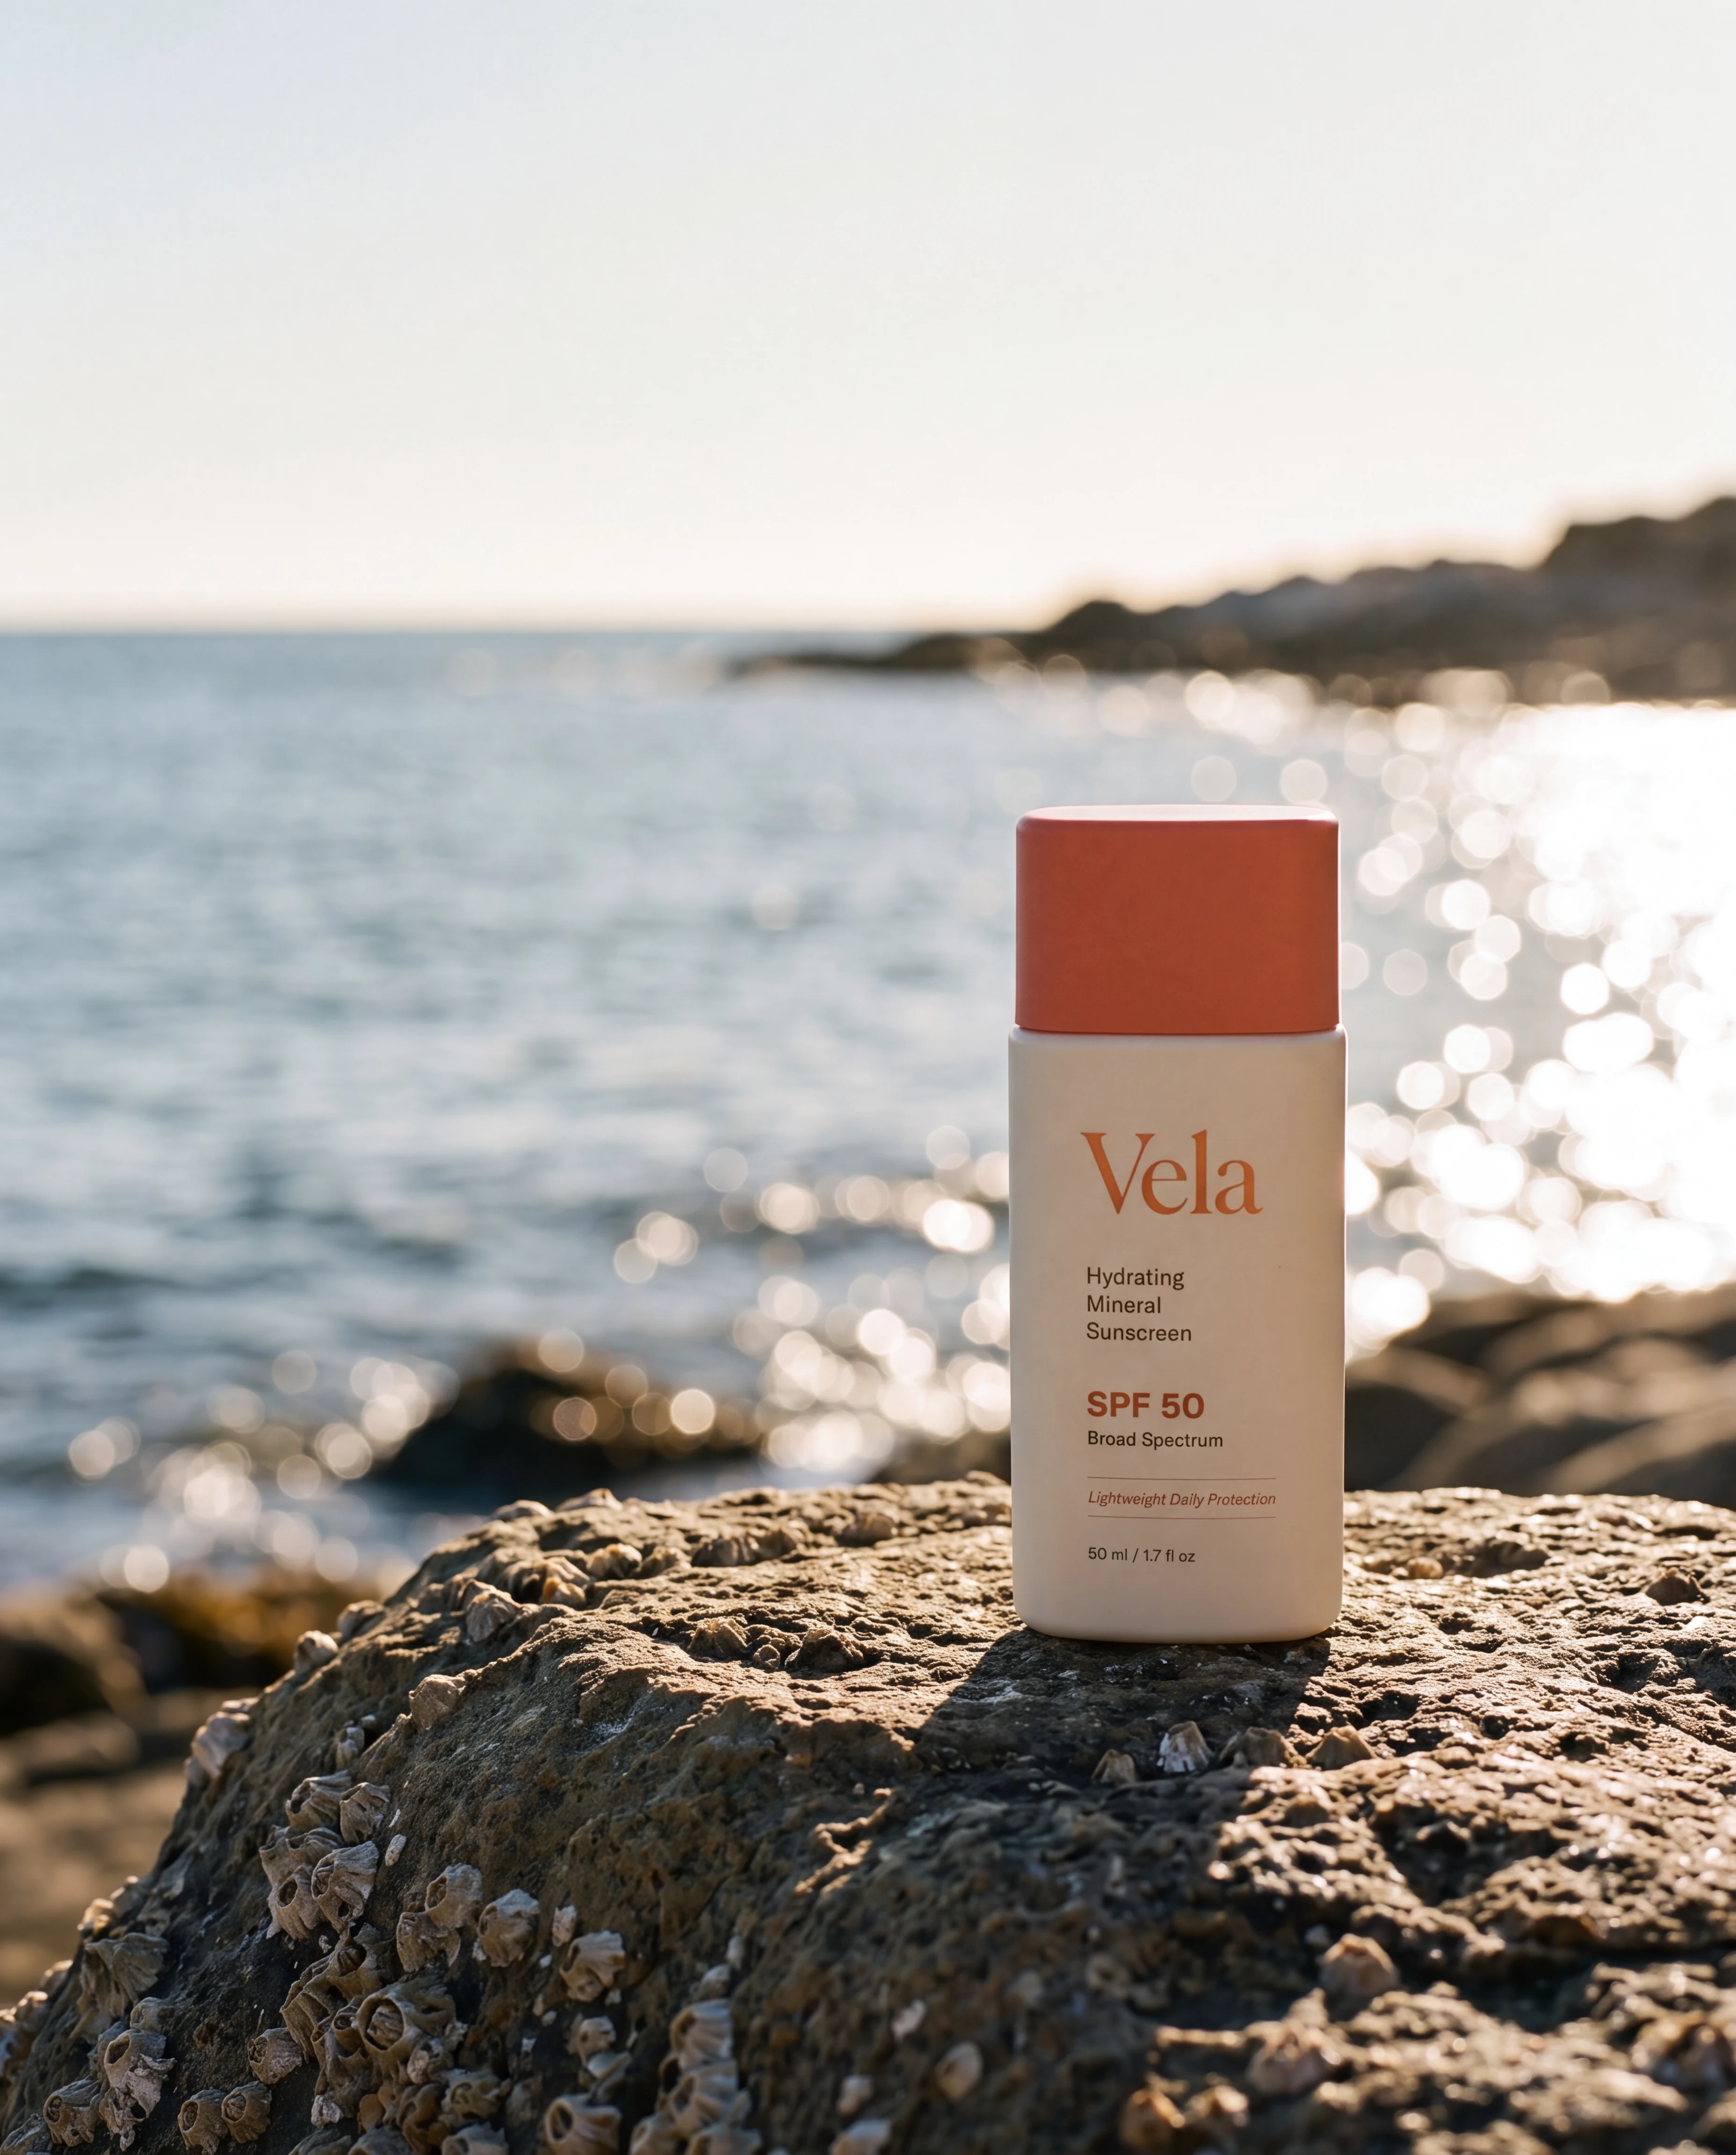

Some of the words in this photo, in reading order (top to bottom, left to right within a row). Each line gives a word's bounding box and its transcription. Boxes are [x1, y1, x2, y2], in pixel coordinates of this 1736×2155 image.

[1080, 1129, 1264, 1215] Vela
[1087, 1266, 1185, 1291] Hydrating
[1087, 1294, 1161, 1314] Mineral
[1086, 1322, 1192, 1342] Sunscreen
[1087, 1391, 1150, 1418] SPF
[1161, 1393, 1205, 1419] 50
[1088, 1430, 1136, 1446] Broad
[1142, 1432, 1223, 1451] Spectrum
[1088, 1491, 1167, 1509] Lightweight
[1170, 1493, 1205, 1509] Daily
[1207, 1493, 1276, 1505] Protection
[1088, 1547, 1107, 1560] 50
[1112, 1548, 1128, 1561] ml
[1132, 1548, 1139, 1563] /
[1143, 1549, 1162, 1562] 1.7
[1165, 1549, 1174, 1562] fl
[1179, 1553, 1195, 1562] oz
